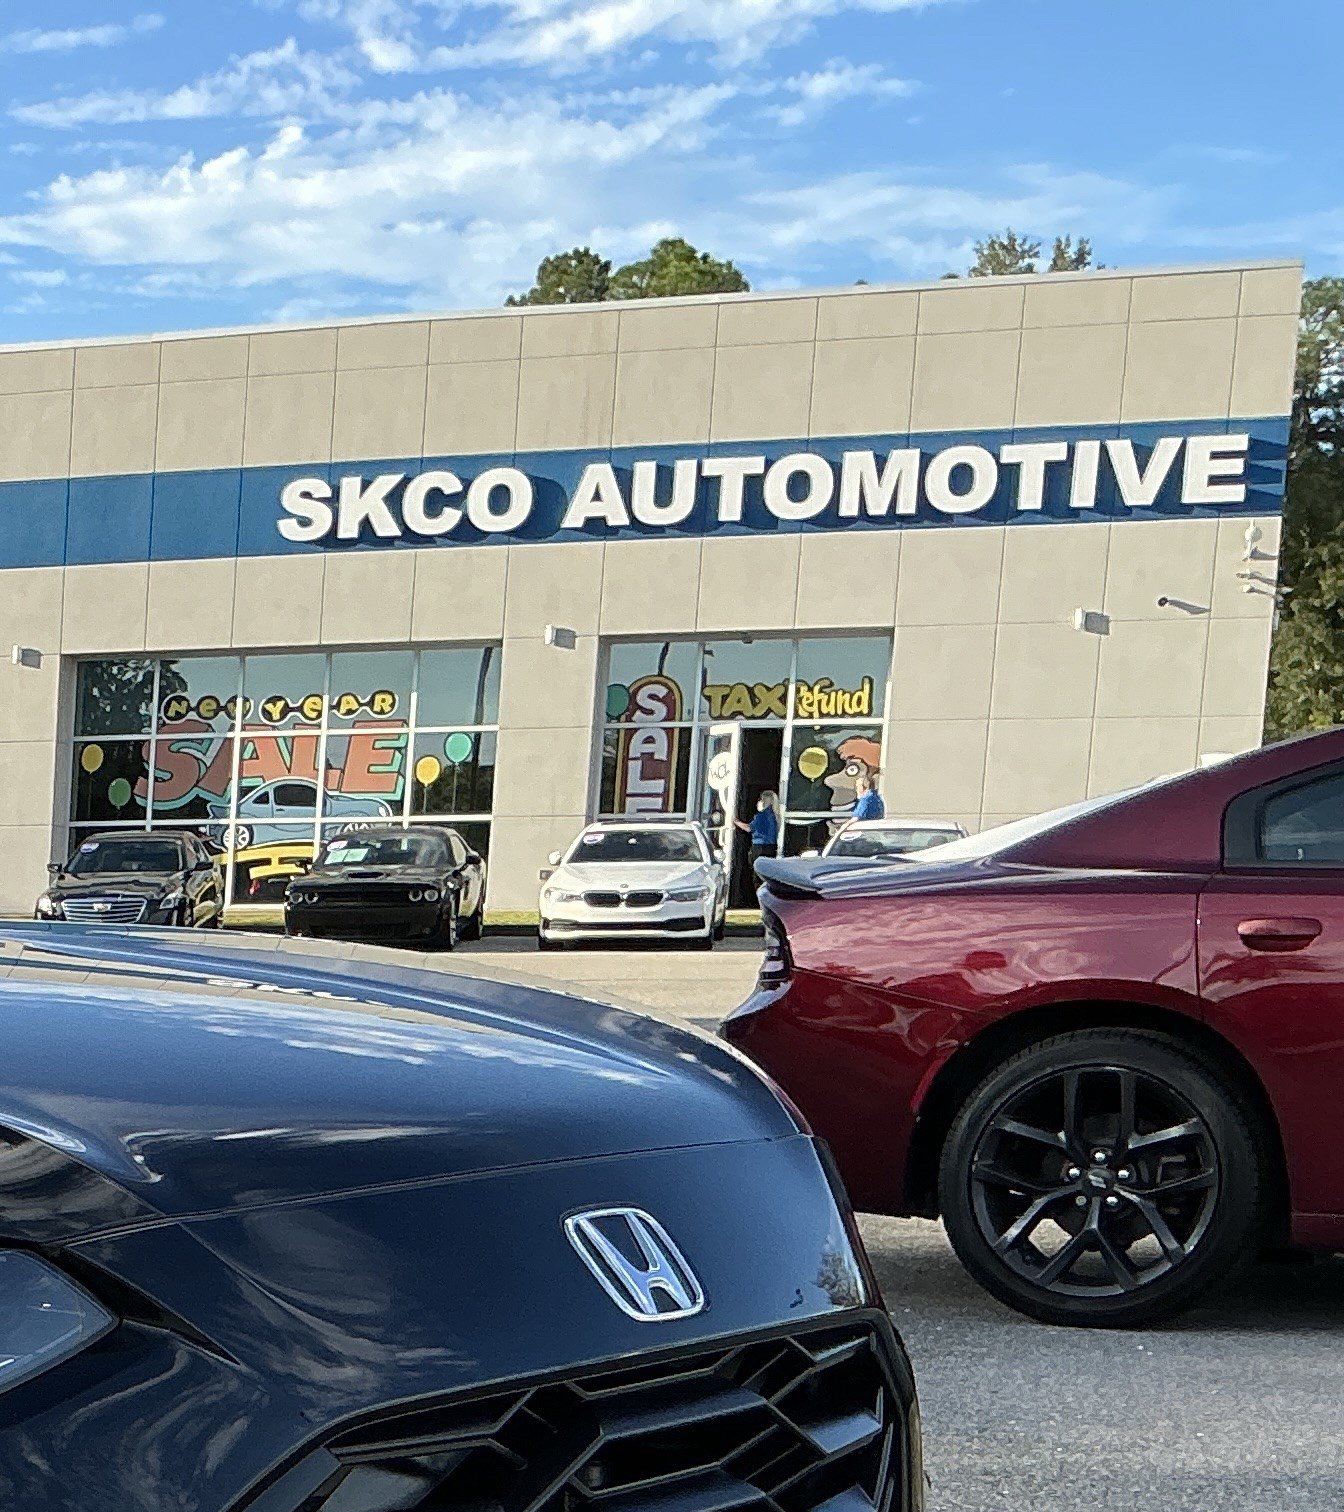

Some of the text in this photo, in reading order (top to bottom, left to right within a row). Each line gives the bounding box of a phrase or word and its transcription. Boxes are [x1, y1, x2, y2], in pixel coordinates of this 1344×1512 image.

[277, 431, 1250, 543] SKCO AUTOMOTIVE
[703, 684, 786, 718] TAX
[133, 719, 408, 808] SALE
